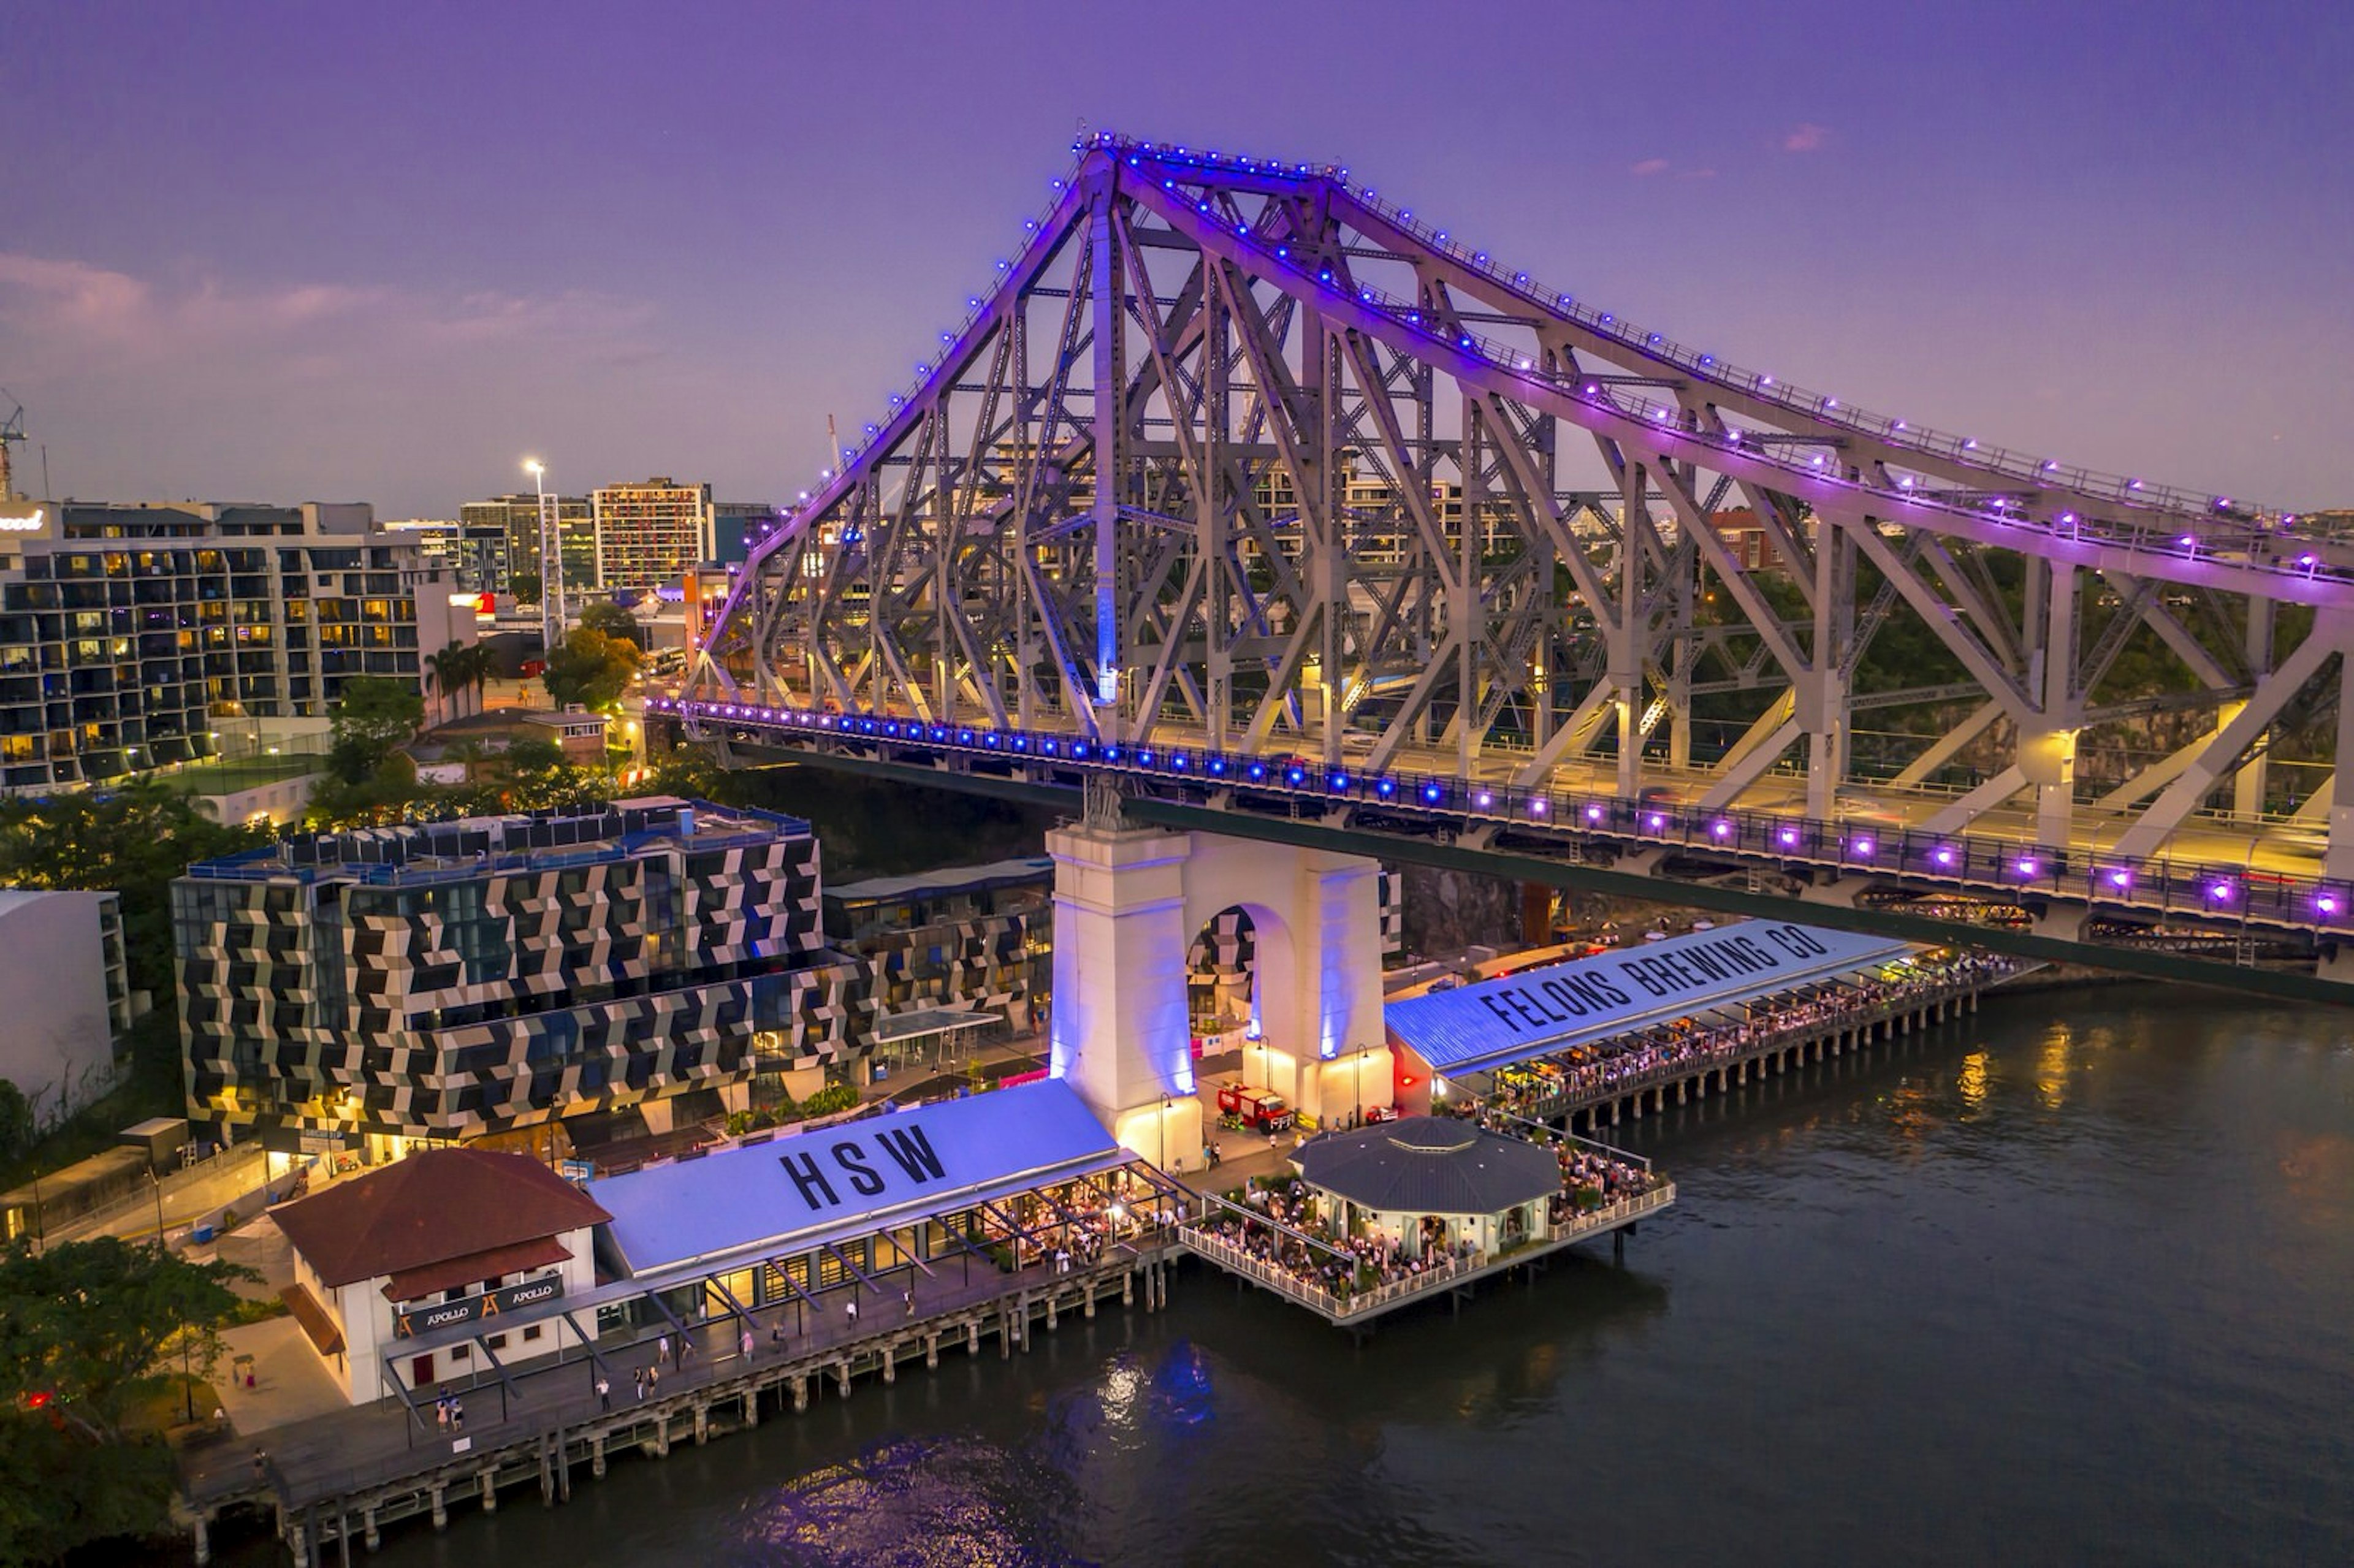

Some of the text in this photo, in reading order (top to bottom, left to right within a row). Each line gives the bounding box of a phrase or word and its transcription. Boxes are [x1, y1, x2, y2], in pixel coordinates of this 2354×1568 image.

[1478, 924, 1828, 1033] FELONS BREWING CO
[779, 1124, 946, 1211] HSW
[427, 1306, 469, 1325] APOLLO
[512, 1285, 552, 1304] APOLLO
